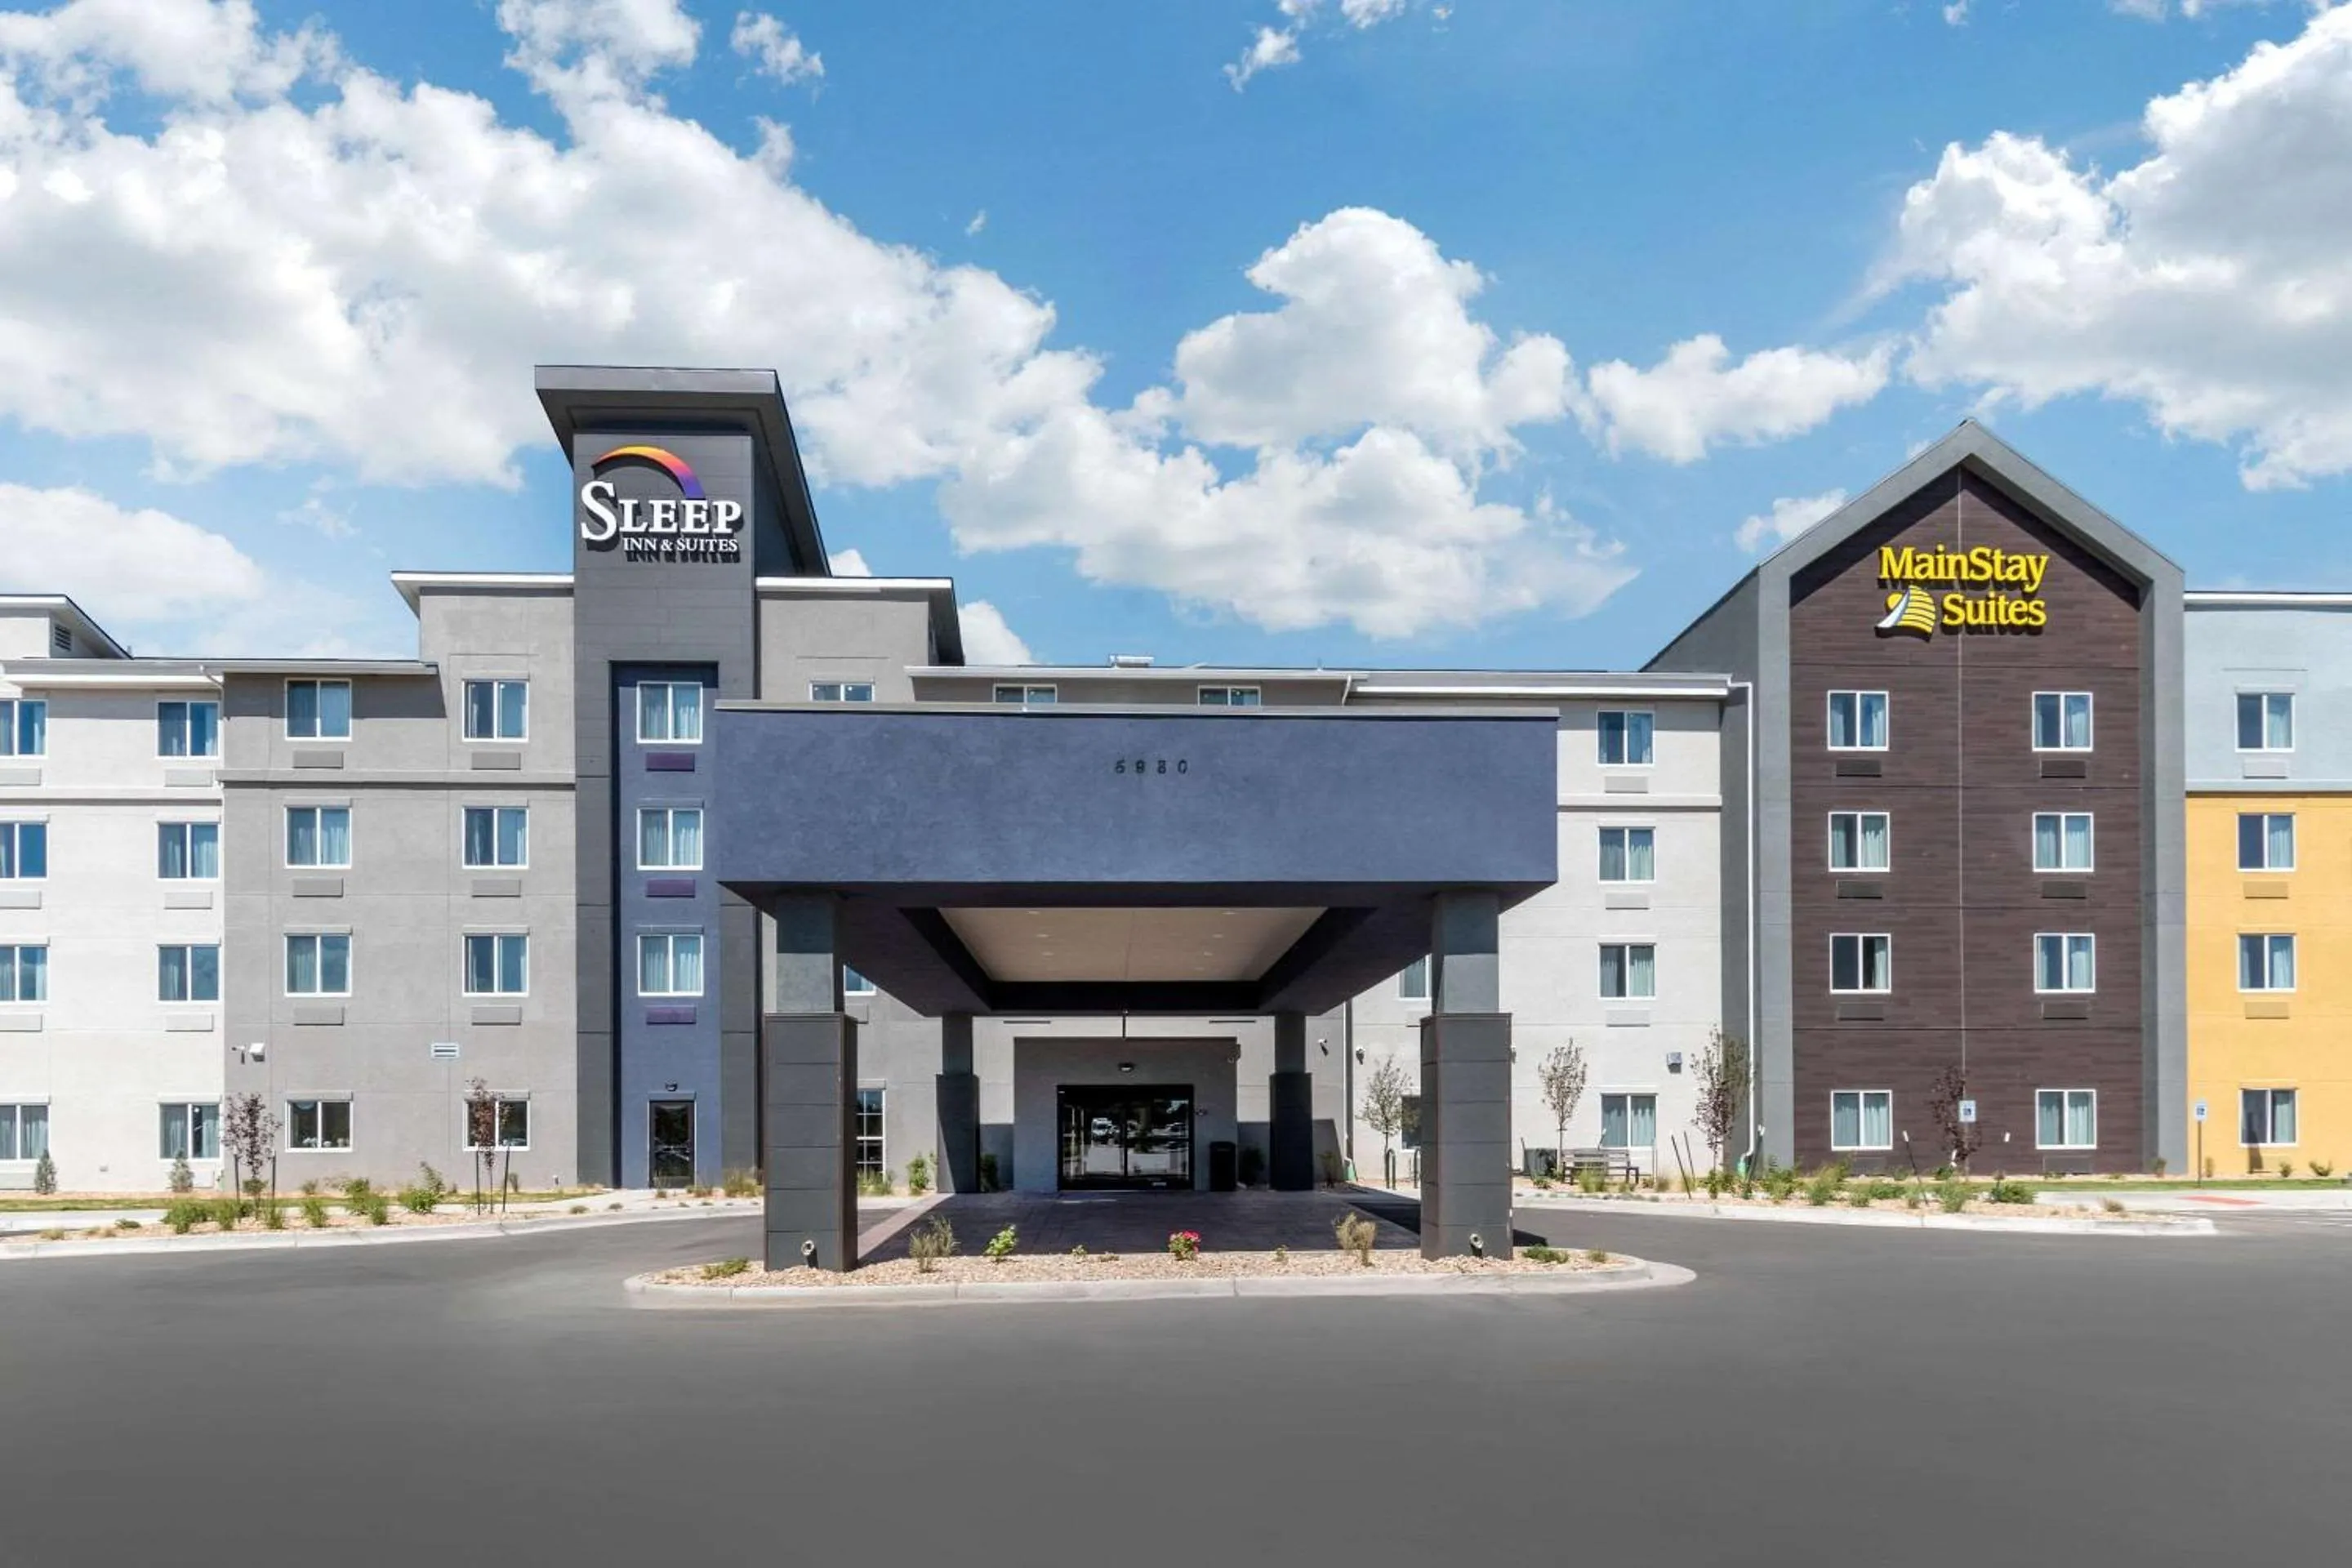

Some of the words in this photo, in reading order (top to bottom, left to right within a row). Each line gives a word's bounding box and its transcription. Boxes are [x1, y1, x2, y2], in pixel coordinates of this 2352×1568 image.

[581, 480, 742, 541] SLEEP
[623, 538, 657, 551] INN
[661, 538, 674, 551] &
[676, 537, 738, 552] SUITES
[1879, 544, 2048, 592] MainStay
[1941, 591, 2047, 626] Suites
